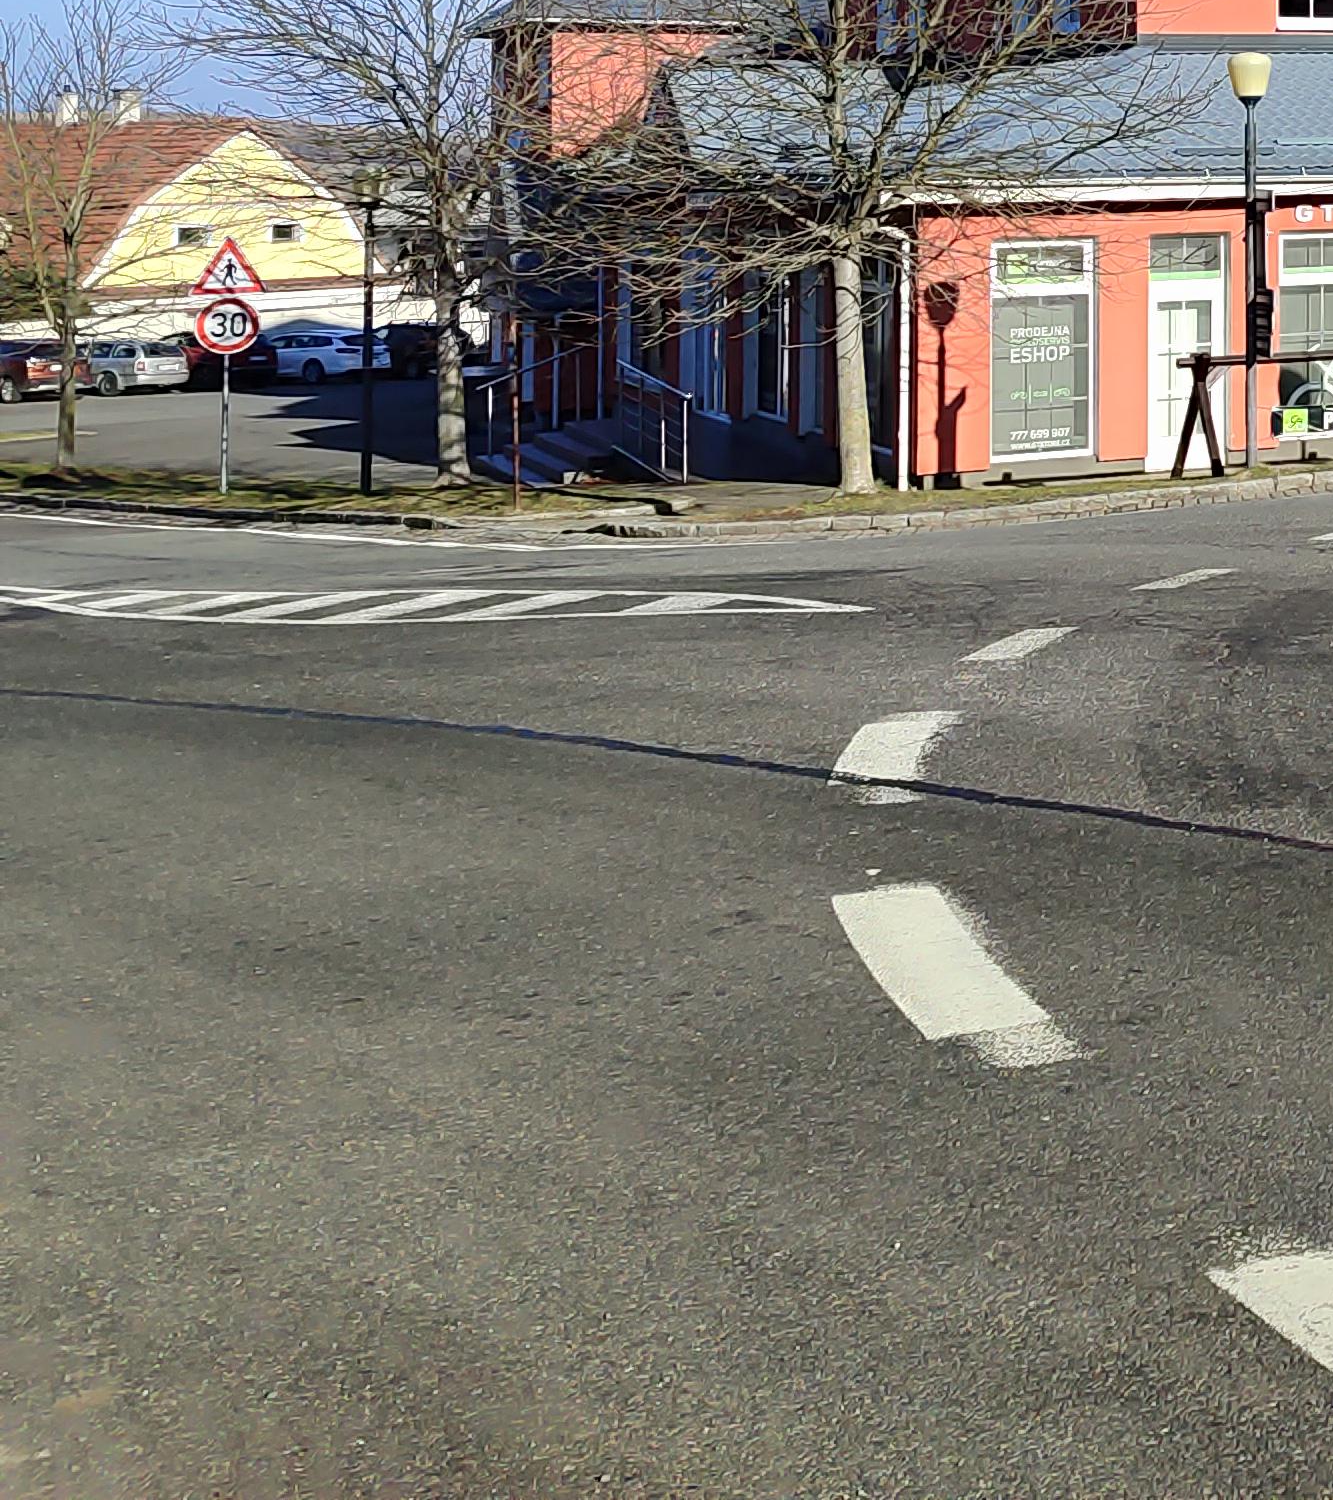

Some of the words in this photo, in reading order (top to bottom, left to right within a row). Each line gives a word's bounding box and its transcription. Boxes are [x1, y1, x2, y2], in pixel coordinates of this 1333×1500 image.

[211, 312, 247, 337] 30
[1010, 325, 1070, 339] PRODEJNA
[1010, 345, 1070, 364] ESHOP
[1010, 430, 1028, 441] 777
